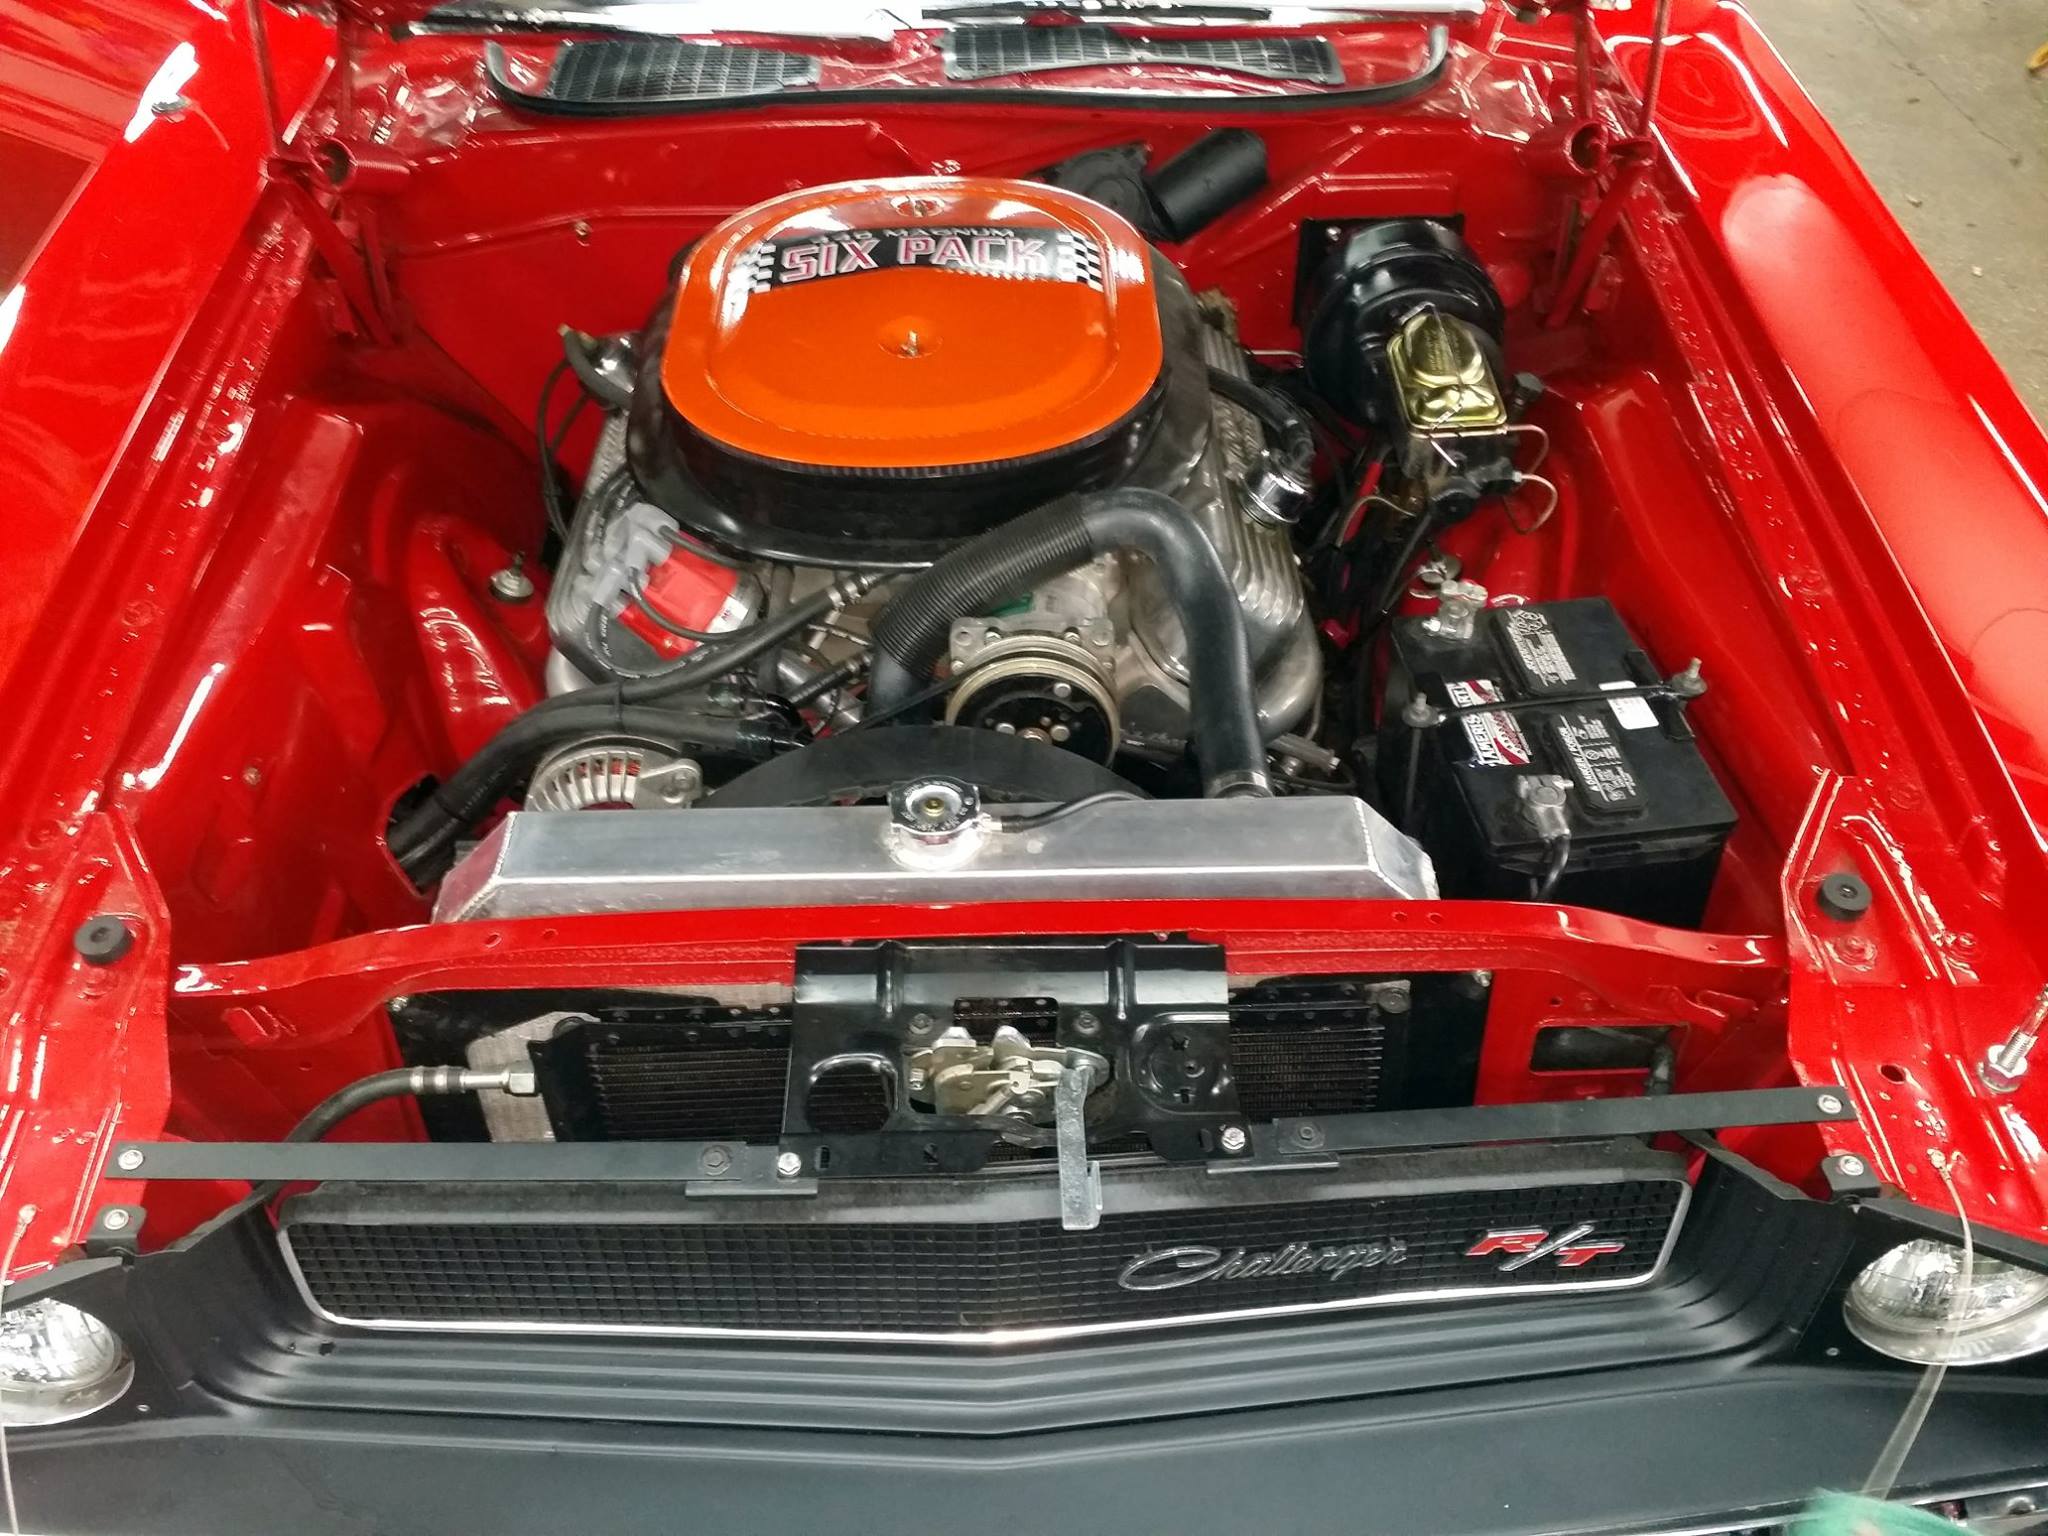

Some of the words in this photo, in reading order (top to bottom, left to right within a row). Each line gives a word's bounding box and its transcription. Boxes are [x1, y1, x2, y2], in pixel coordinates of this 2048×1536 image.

[779, 238, 881, 284] SIX
[896, 235, 1047, 275] PACK
[1117, 1238, 1408, 1291] Challenger
[1464, 1220, 1625, 1272] R/T
